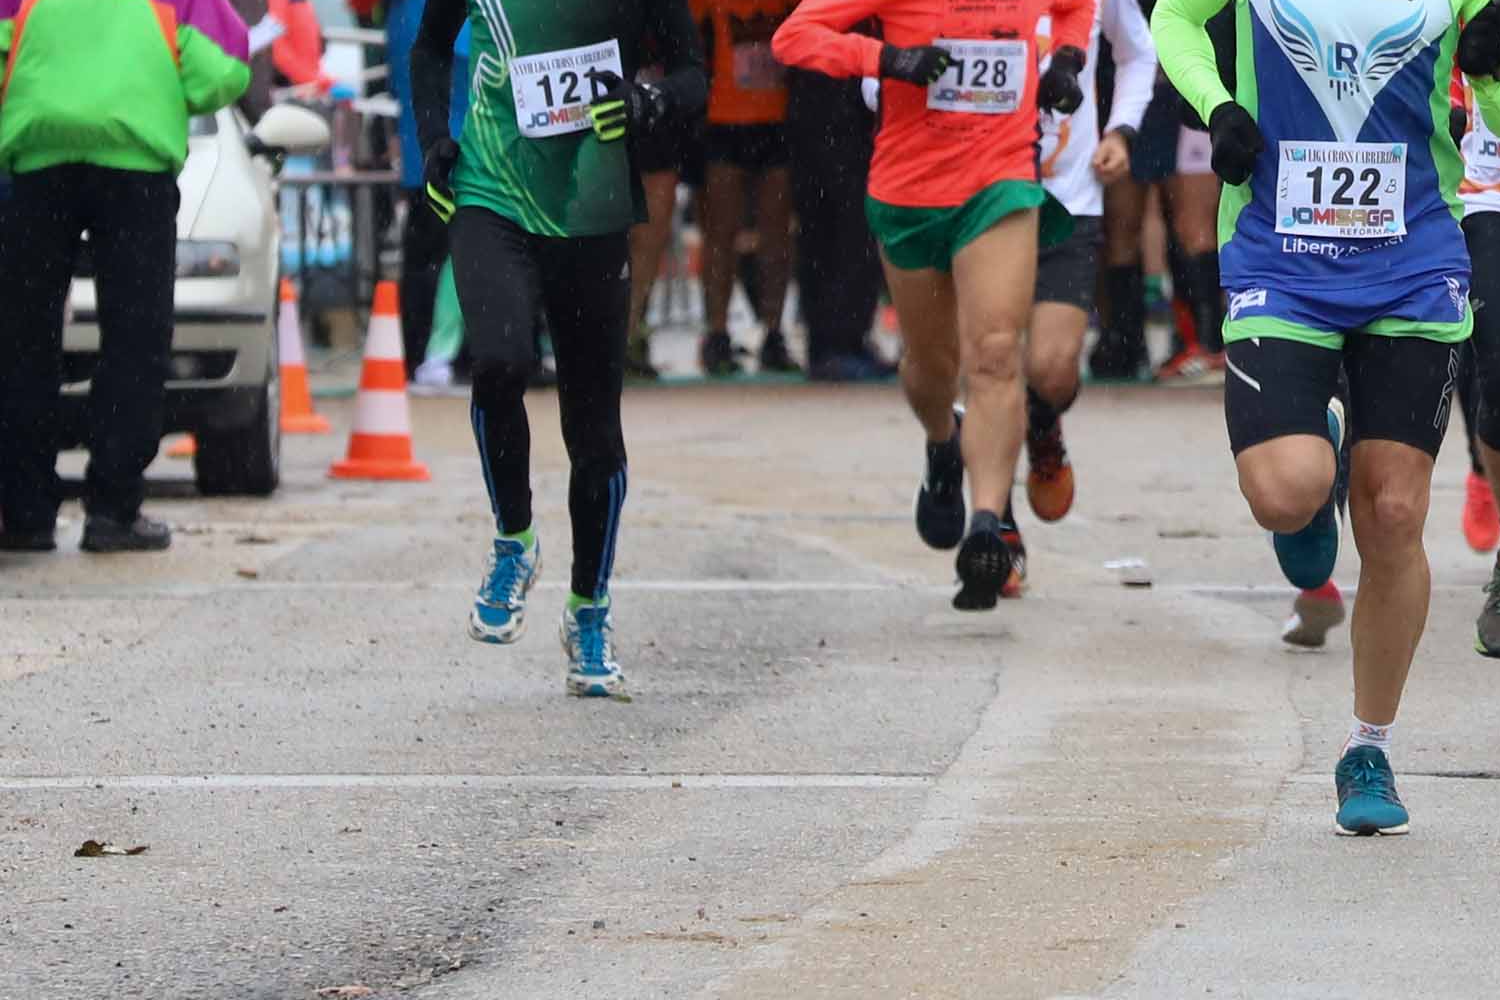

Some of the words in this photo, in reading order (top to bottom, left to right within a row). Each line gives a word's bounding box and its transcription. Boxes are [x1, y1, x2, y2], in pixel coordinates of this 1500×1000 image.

[954, 59, 1008, 88] 128
[1306, 166, 1381, 206] 122
[1282, 236, 1344, 260] Liberty
